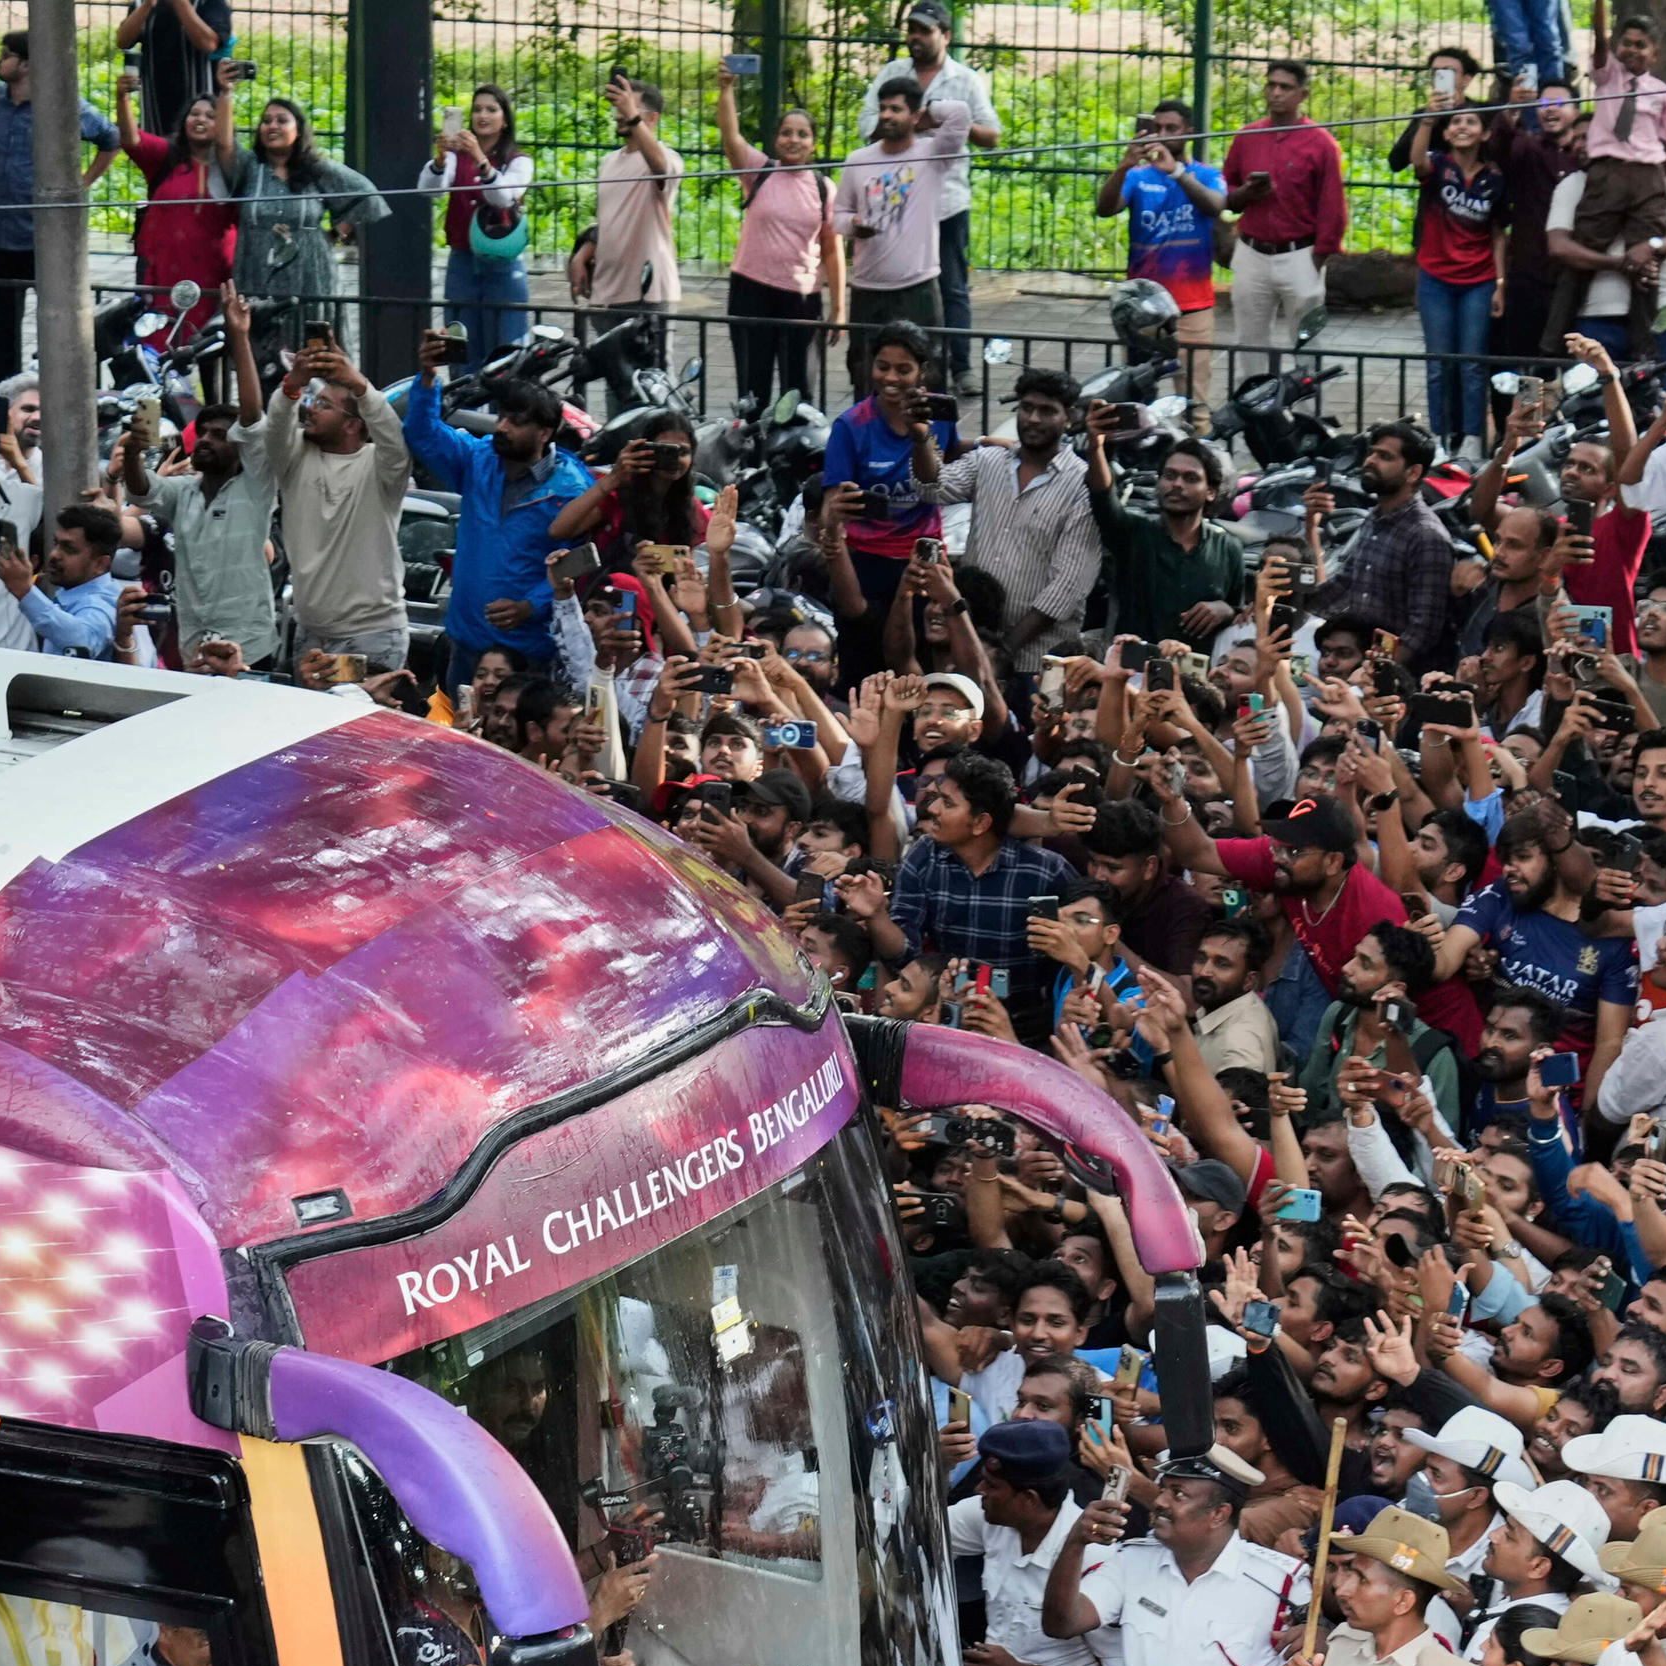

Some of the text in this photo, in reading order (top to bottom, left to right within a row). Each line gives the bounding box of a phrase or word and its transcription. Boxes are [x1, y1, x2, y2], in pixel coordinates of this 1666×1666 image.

[395, 1051, 844, 1315] ROYAL CHALLENGERS BENGALURU
